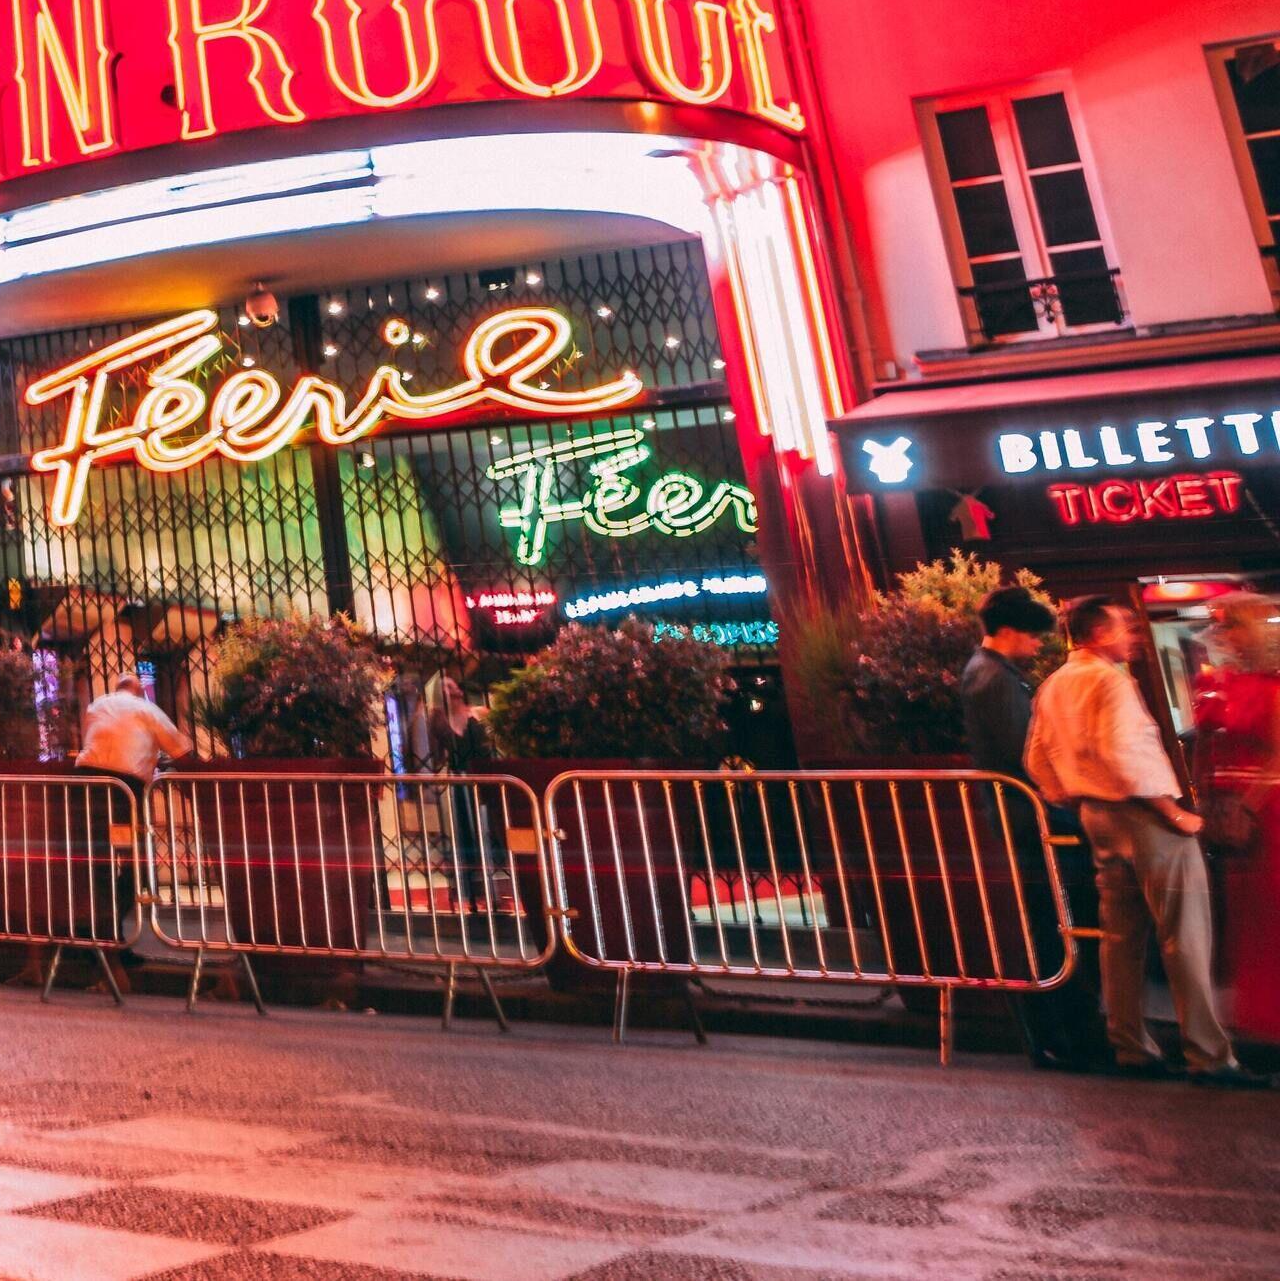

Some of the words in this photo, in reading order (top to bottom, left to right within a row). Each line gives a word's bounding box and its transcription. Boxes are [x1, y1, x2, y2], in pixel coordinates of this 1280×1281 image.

[25, 308, 644, 526] Féerie
[998, 410, 1280, 473] BILLETT
[1048, 471, 1241, 524] TICKET
